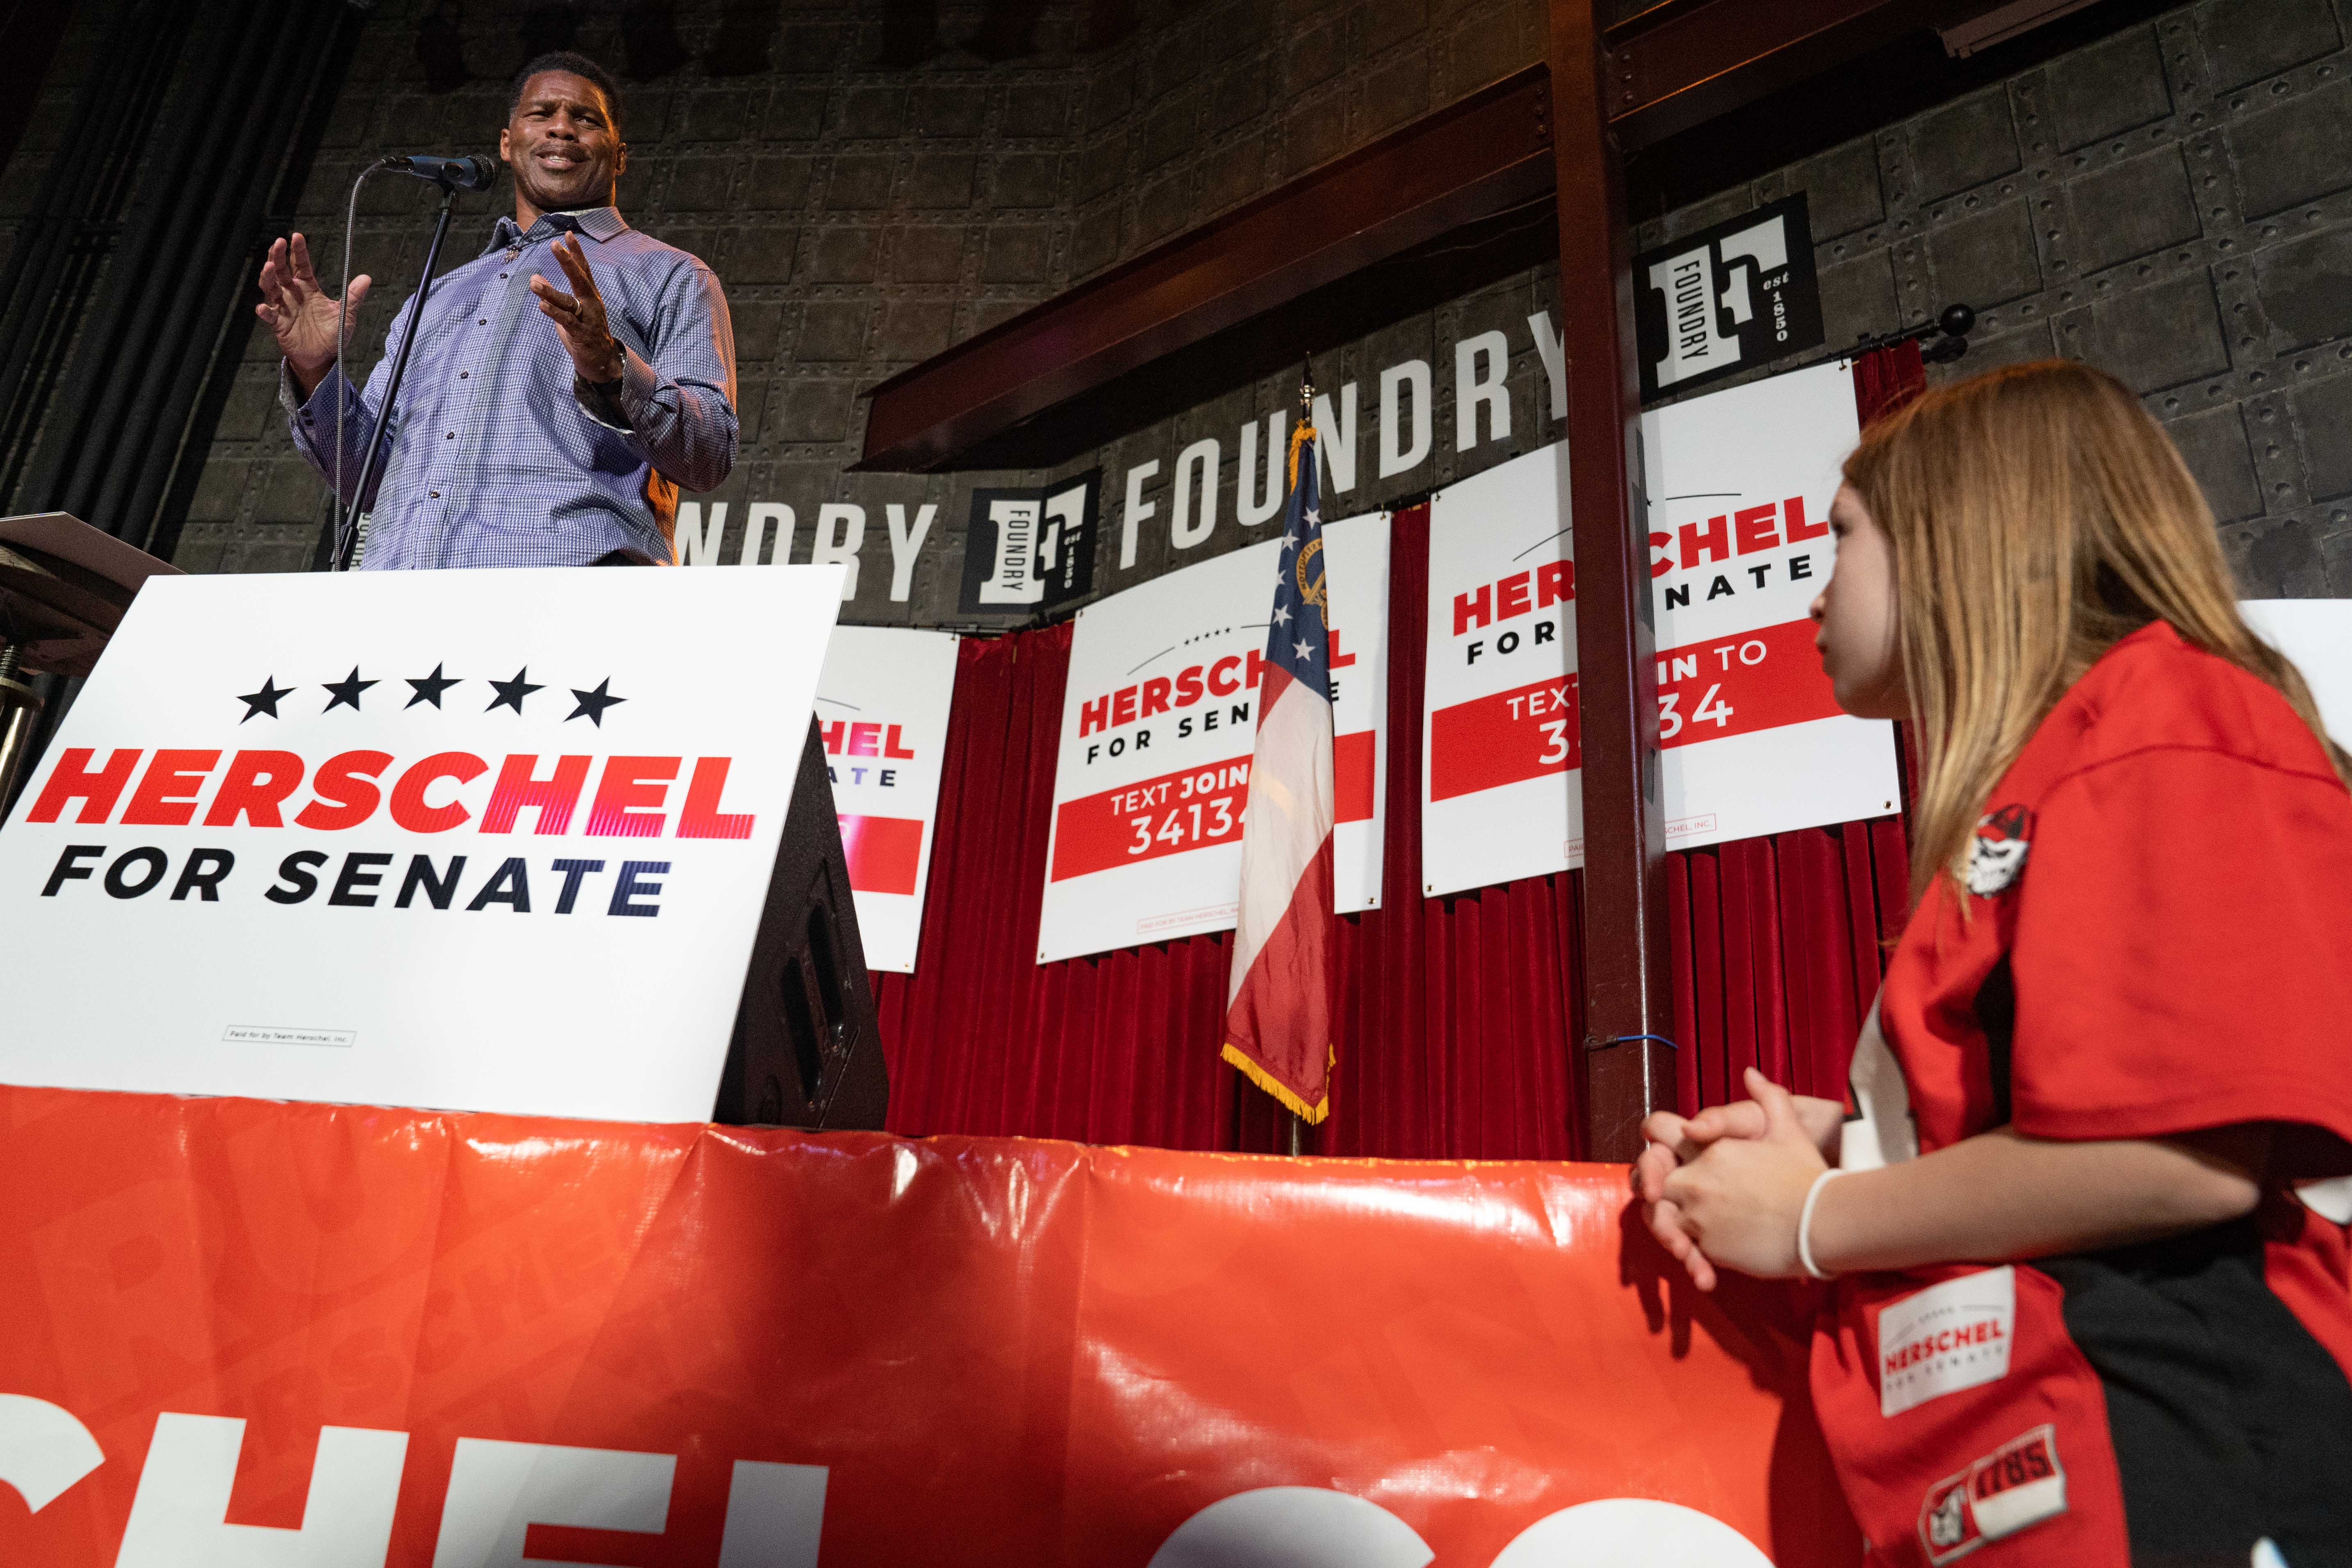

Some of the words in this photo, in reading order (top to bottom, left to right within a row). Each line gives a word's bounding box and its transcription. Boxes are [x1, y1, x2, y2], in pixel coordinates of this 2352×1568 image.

[1674, 260, 1708, 360] FOUNDRY
[1764, 271, 1789, 290] est
[1773, 291, 1788, 342] 1850
[679, 501, 938, 602] NDRY
[1002, 511, 1030, 590] FOUNDRY
[1454, 496, 1828, 636] HERCHEL
[1467, 621, 1555, 665] FOR
[1666, 554, 1812, 610] NATE
[1079, 629, 1356, 738] HERSCHL
[1658, 654, 1697, 685] IN
[1714, 640, 1766, 670] TO
[1087, 731, 1151, 765] FOR
[1178, 681, 1340, 738] SENE
[1538, 683, 1733, 765] 334
[27, 748, 756, 839] HERSCHEL
[1111, 782, 1172, 816] TEXT
[1179, 763, 1249, 799] JOIN
[1694, 820, 1712, 829] INC.
[41, 845, 235, 902] FOR
[264, 850, 672, 918] SENATE
[1886, 1318, 2003, 1375] HERSCHEL
